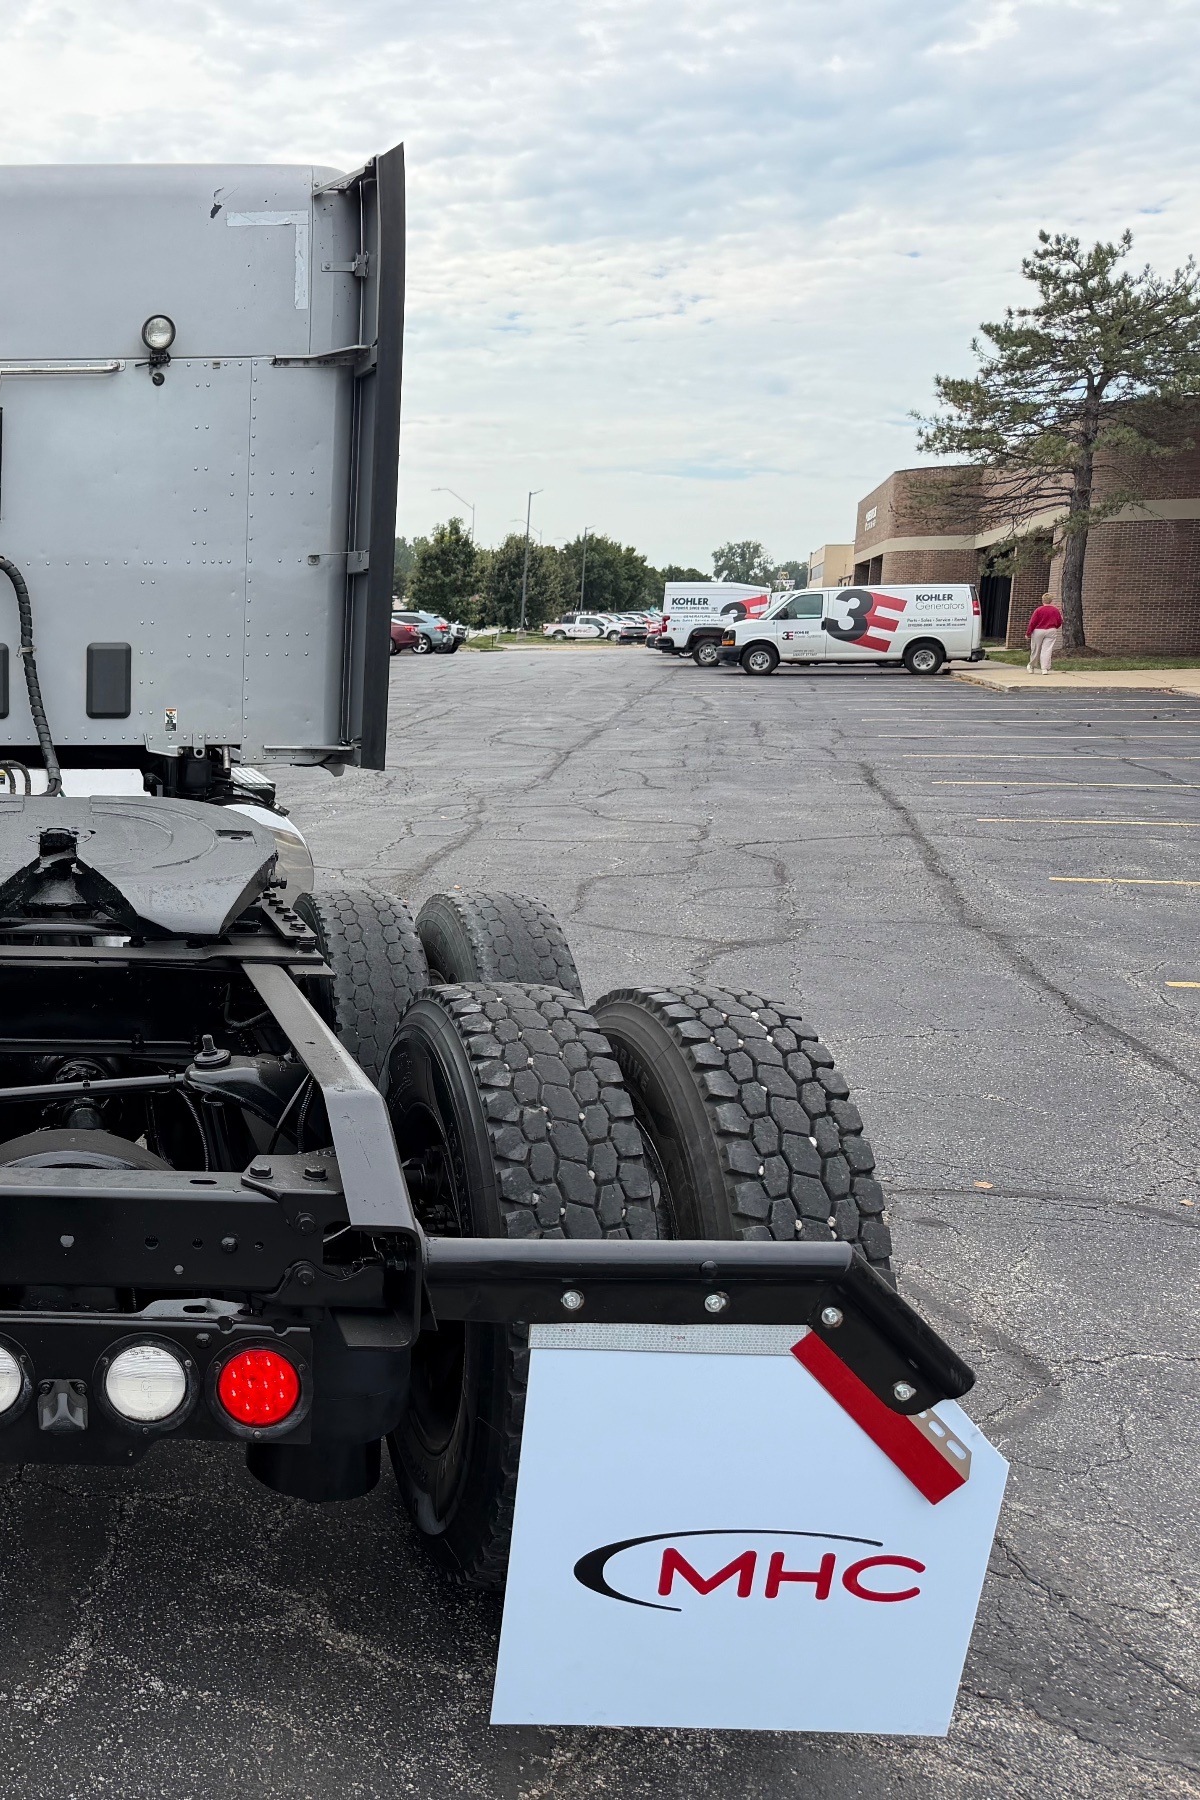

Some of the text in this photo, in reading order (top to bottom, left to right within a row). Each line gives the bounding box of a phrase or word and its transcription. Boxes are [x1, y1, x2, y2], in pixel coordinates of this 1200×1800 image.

[672, 597, 709, 606] KOHLER
[915, 602, 965, 610] Generators
[825, 589, 907, 653] 3E
[782, 631, 793, 640] 3E
[657, 1547, 926, 1603] MHC
